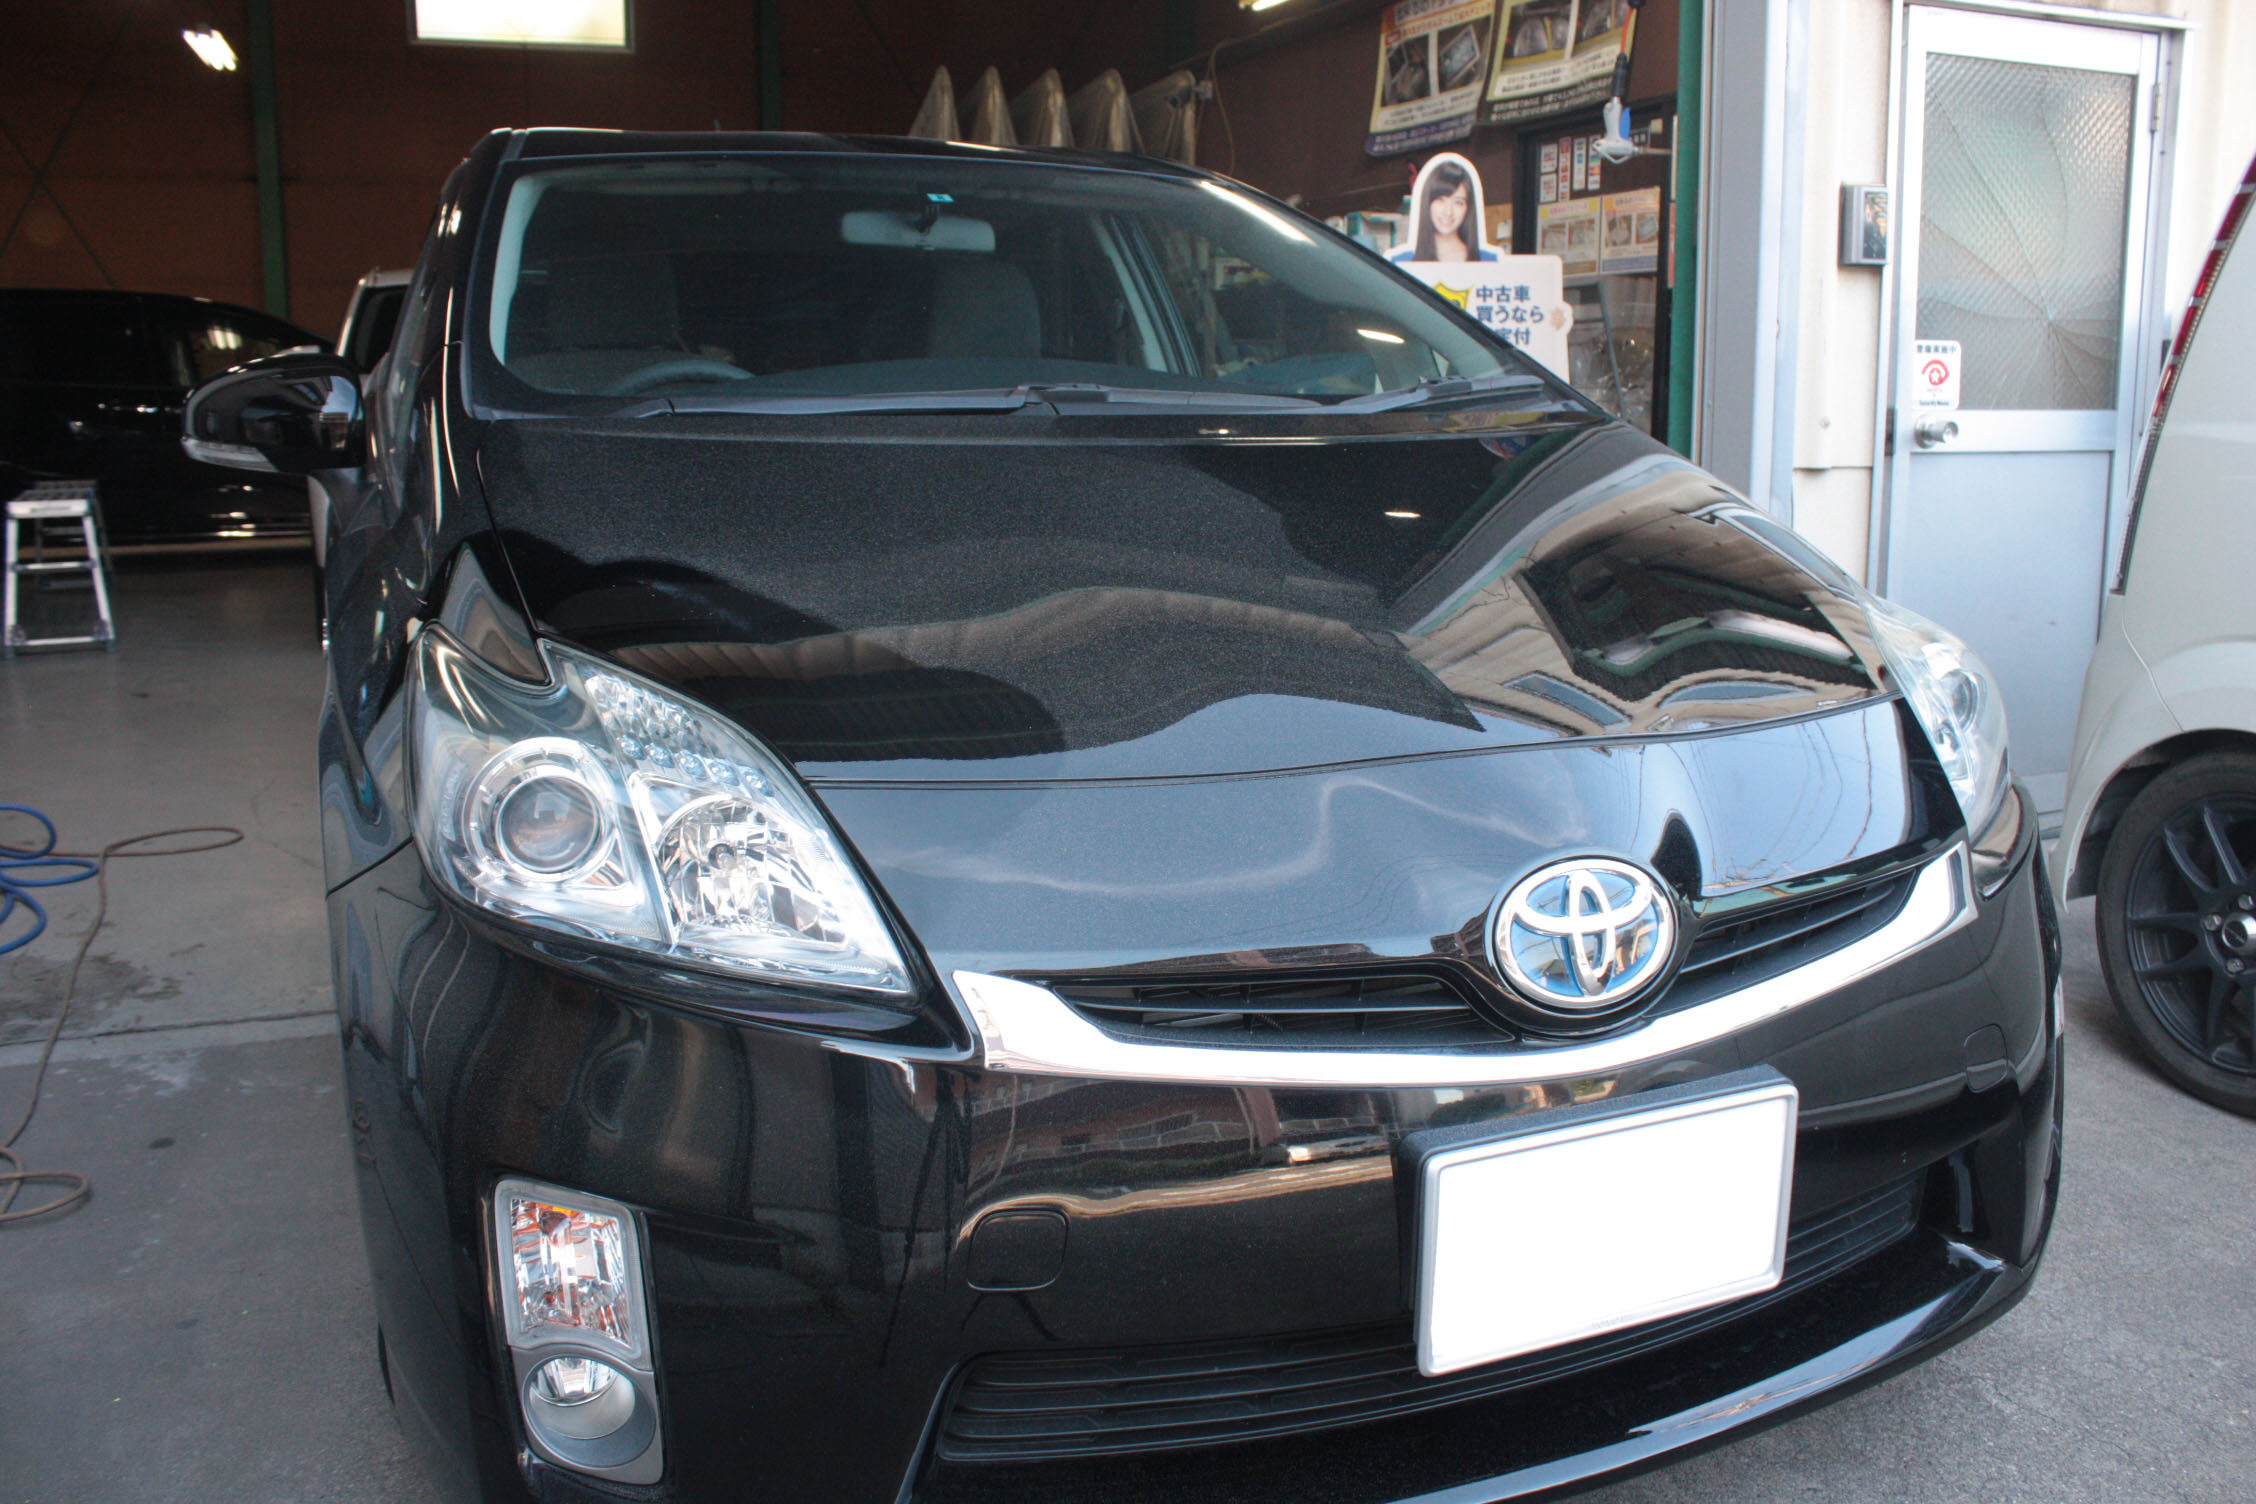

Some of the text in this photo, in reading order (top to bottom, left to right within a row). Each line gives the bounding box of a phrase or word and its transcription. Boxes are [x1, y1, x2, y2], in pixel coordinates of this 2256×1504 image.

[1476, 285, 1531, 302] 中古車
[1476, 305, 1544, 323] 買うなら
